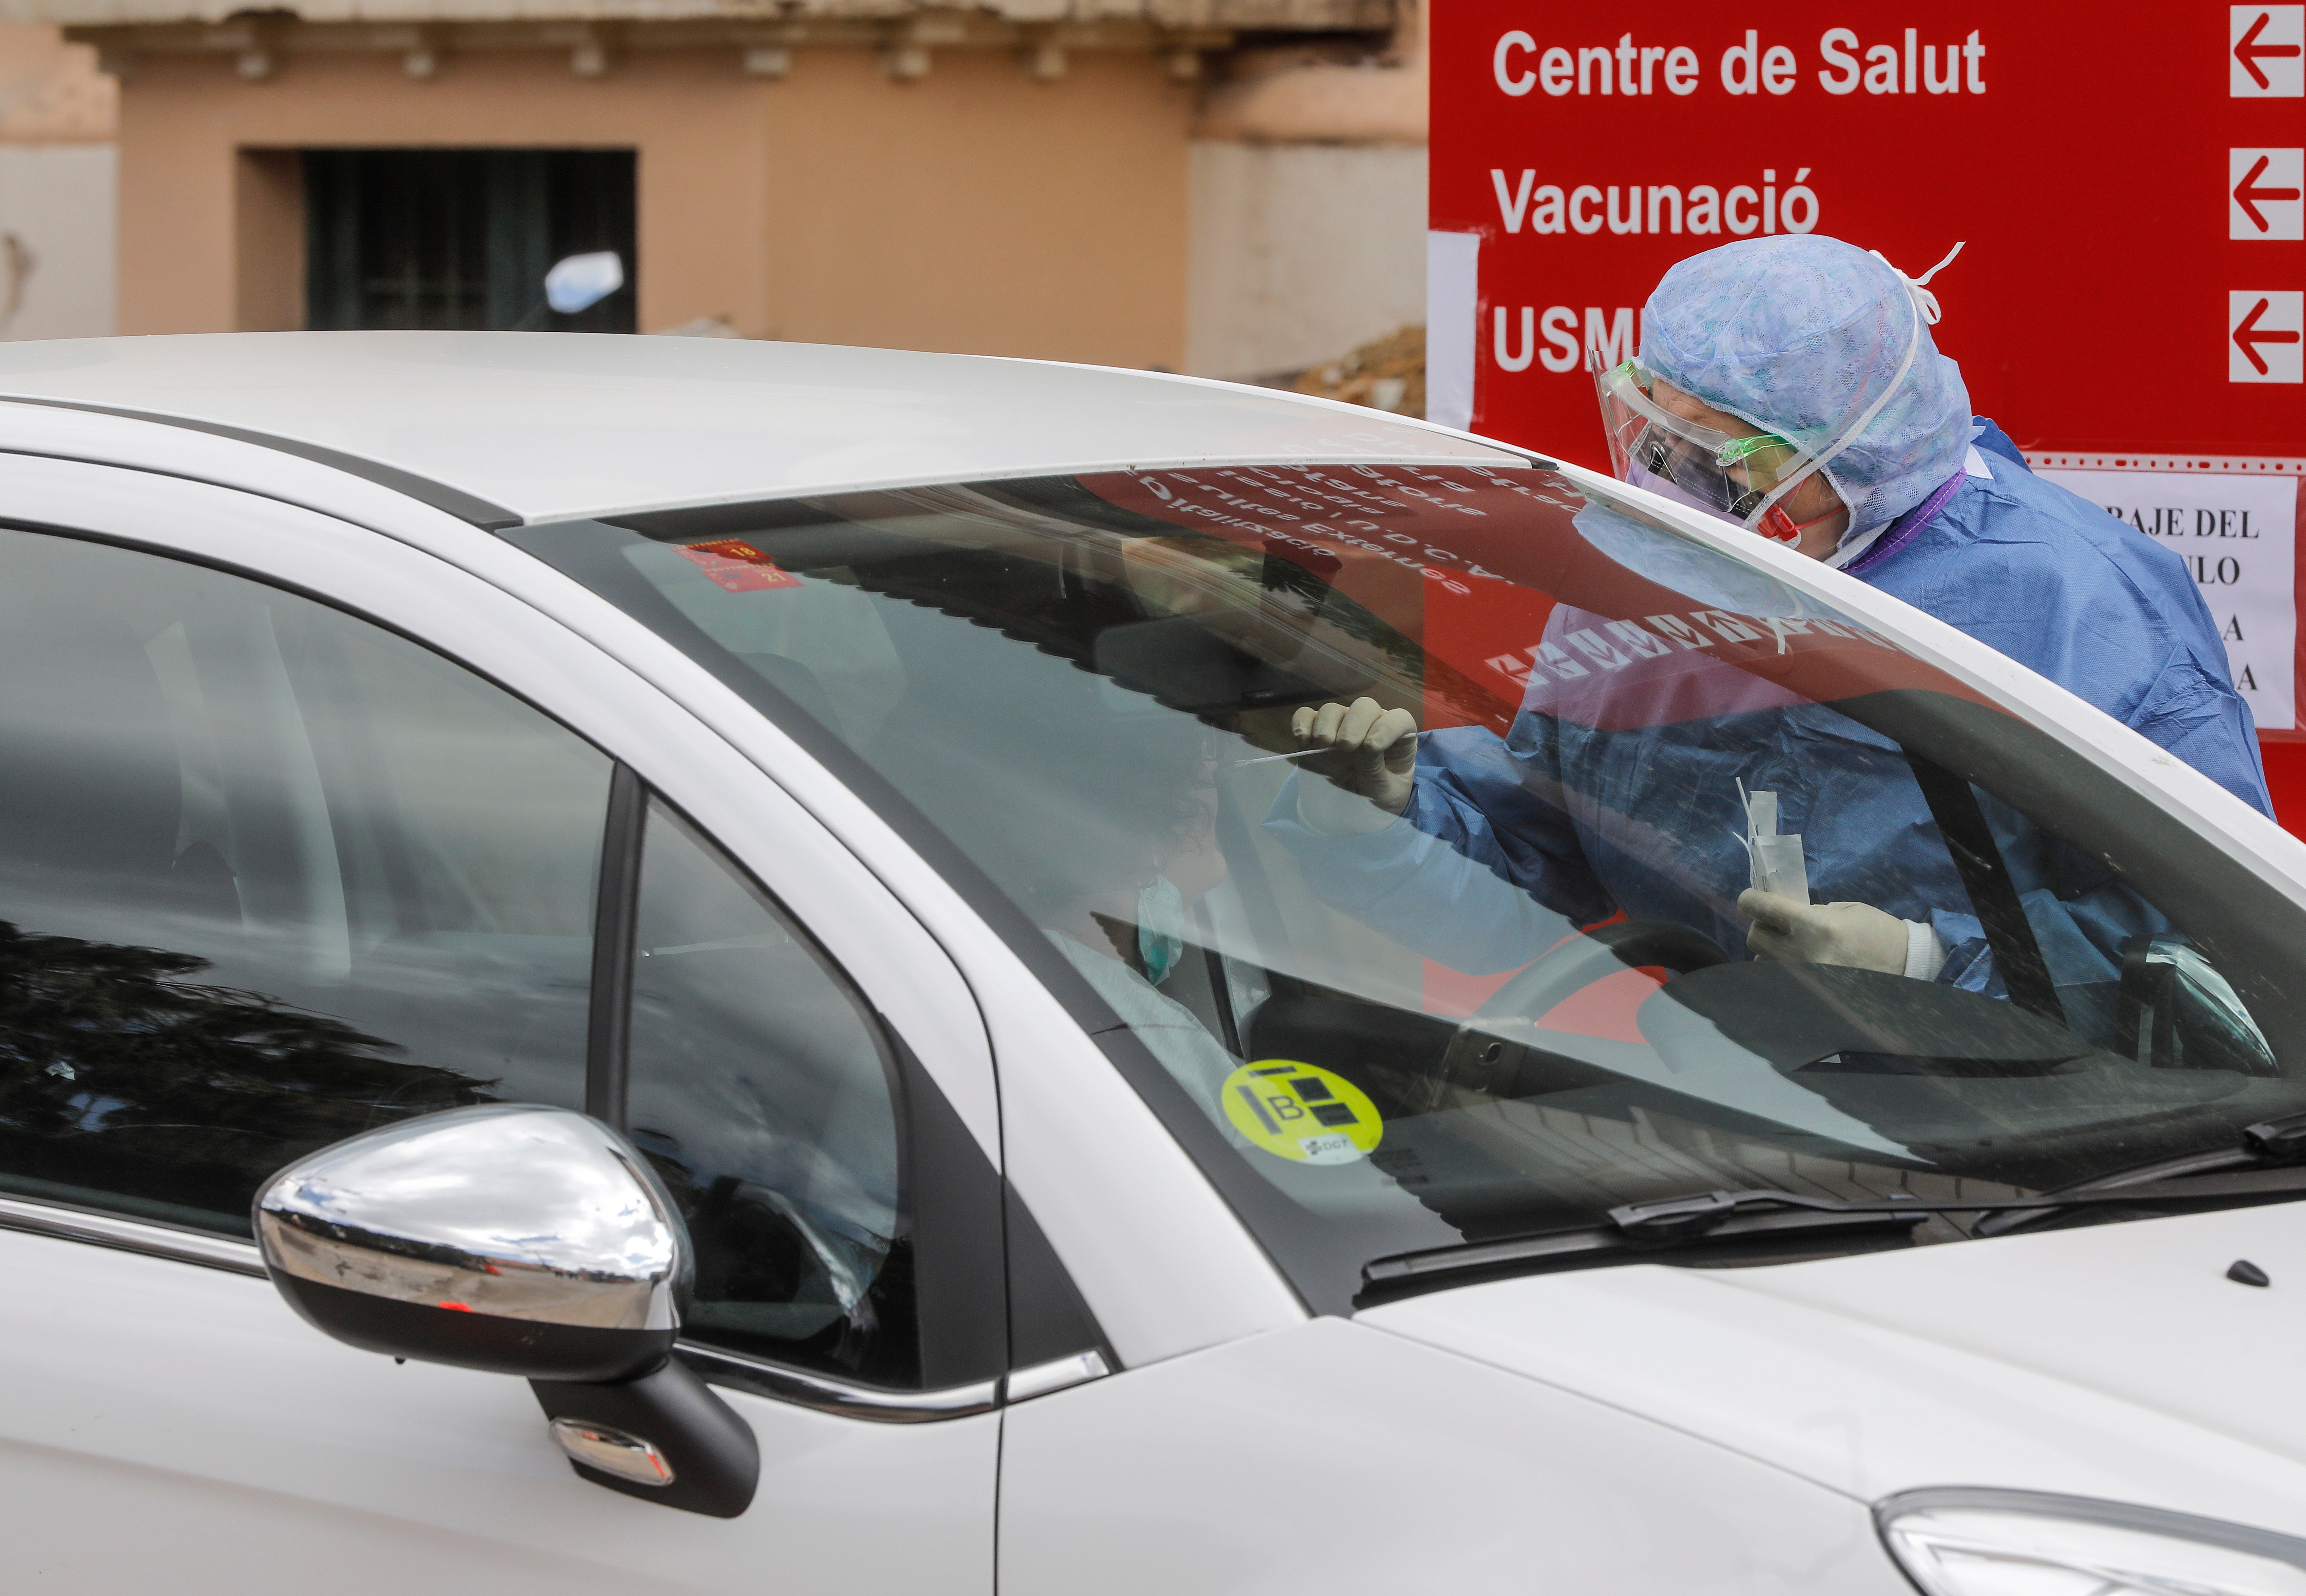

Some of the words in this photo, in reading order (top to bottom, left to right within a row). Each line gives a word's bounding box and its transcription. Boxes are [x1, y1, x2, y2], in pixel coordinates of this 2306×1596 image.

[1493, 30, 1699, 97] Centre
[1720, 30, 1796, 96] de
[1817, 28, 1986, 96] Salut
[1490, 168, 1820, 235] Vacunació
[1494, 306, 1645, 373] USM
[2196, 509, 2259, 538] DEL
[1267, 1095, 1304, 1120] B
[1323, 1138, 1348, 1152] DGT
